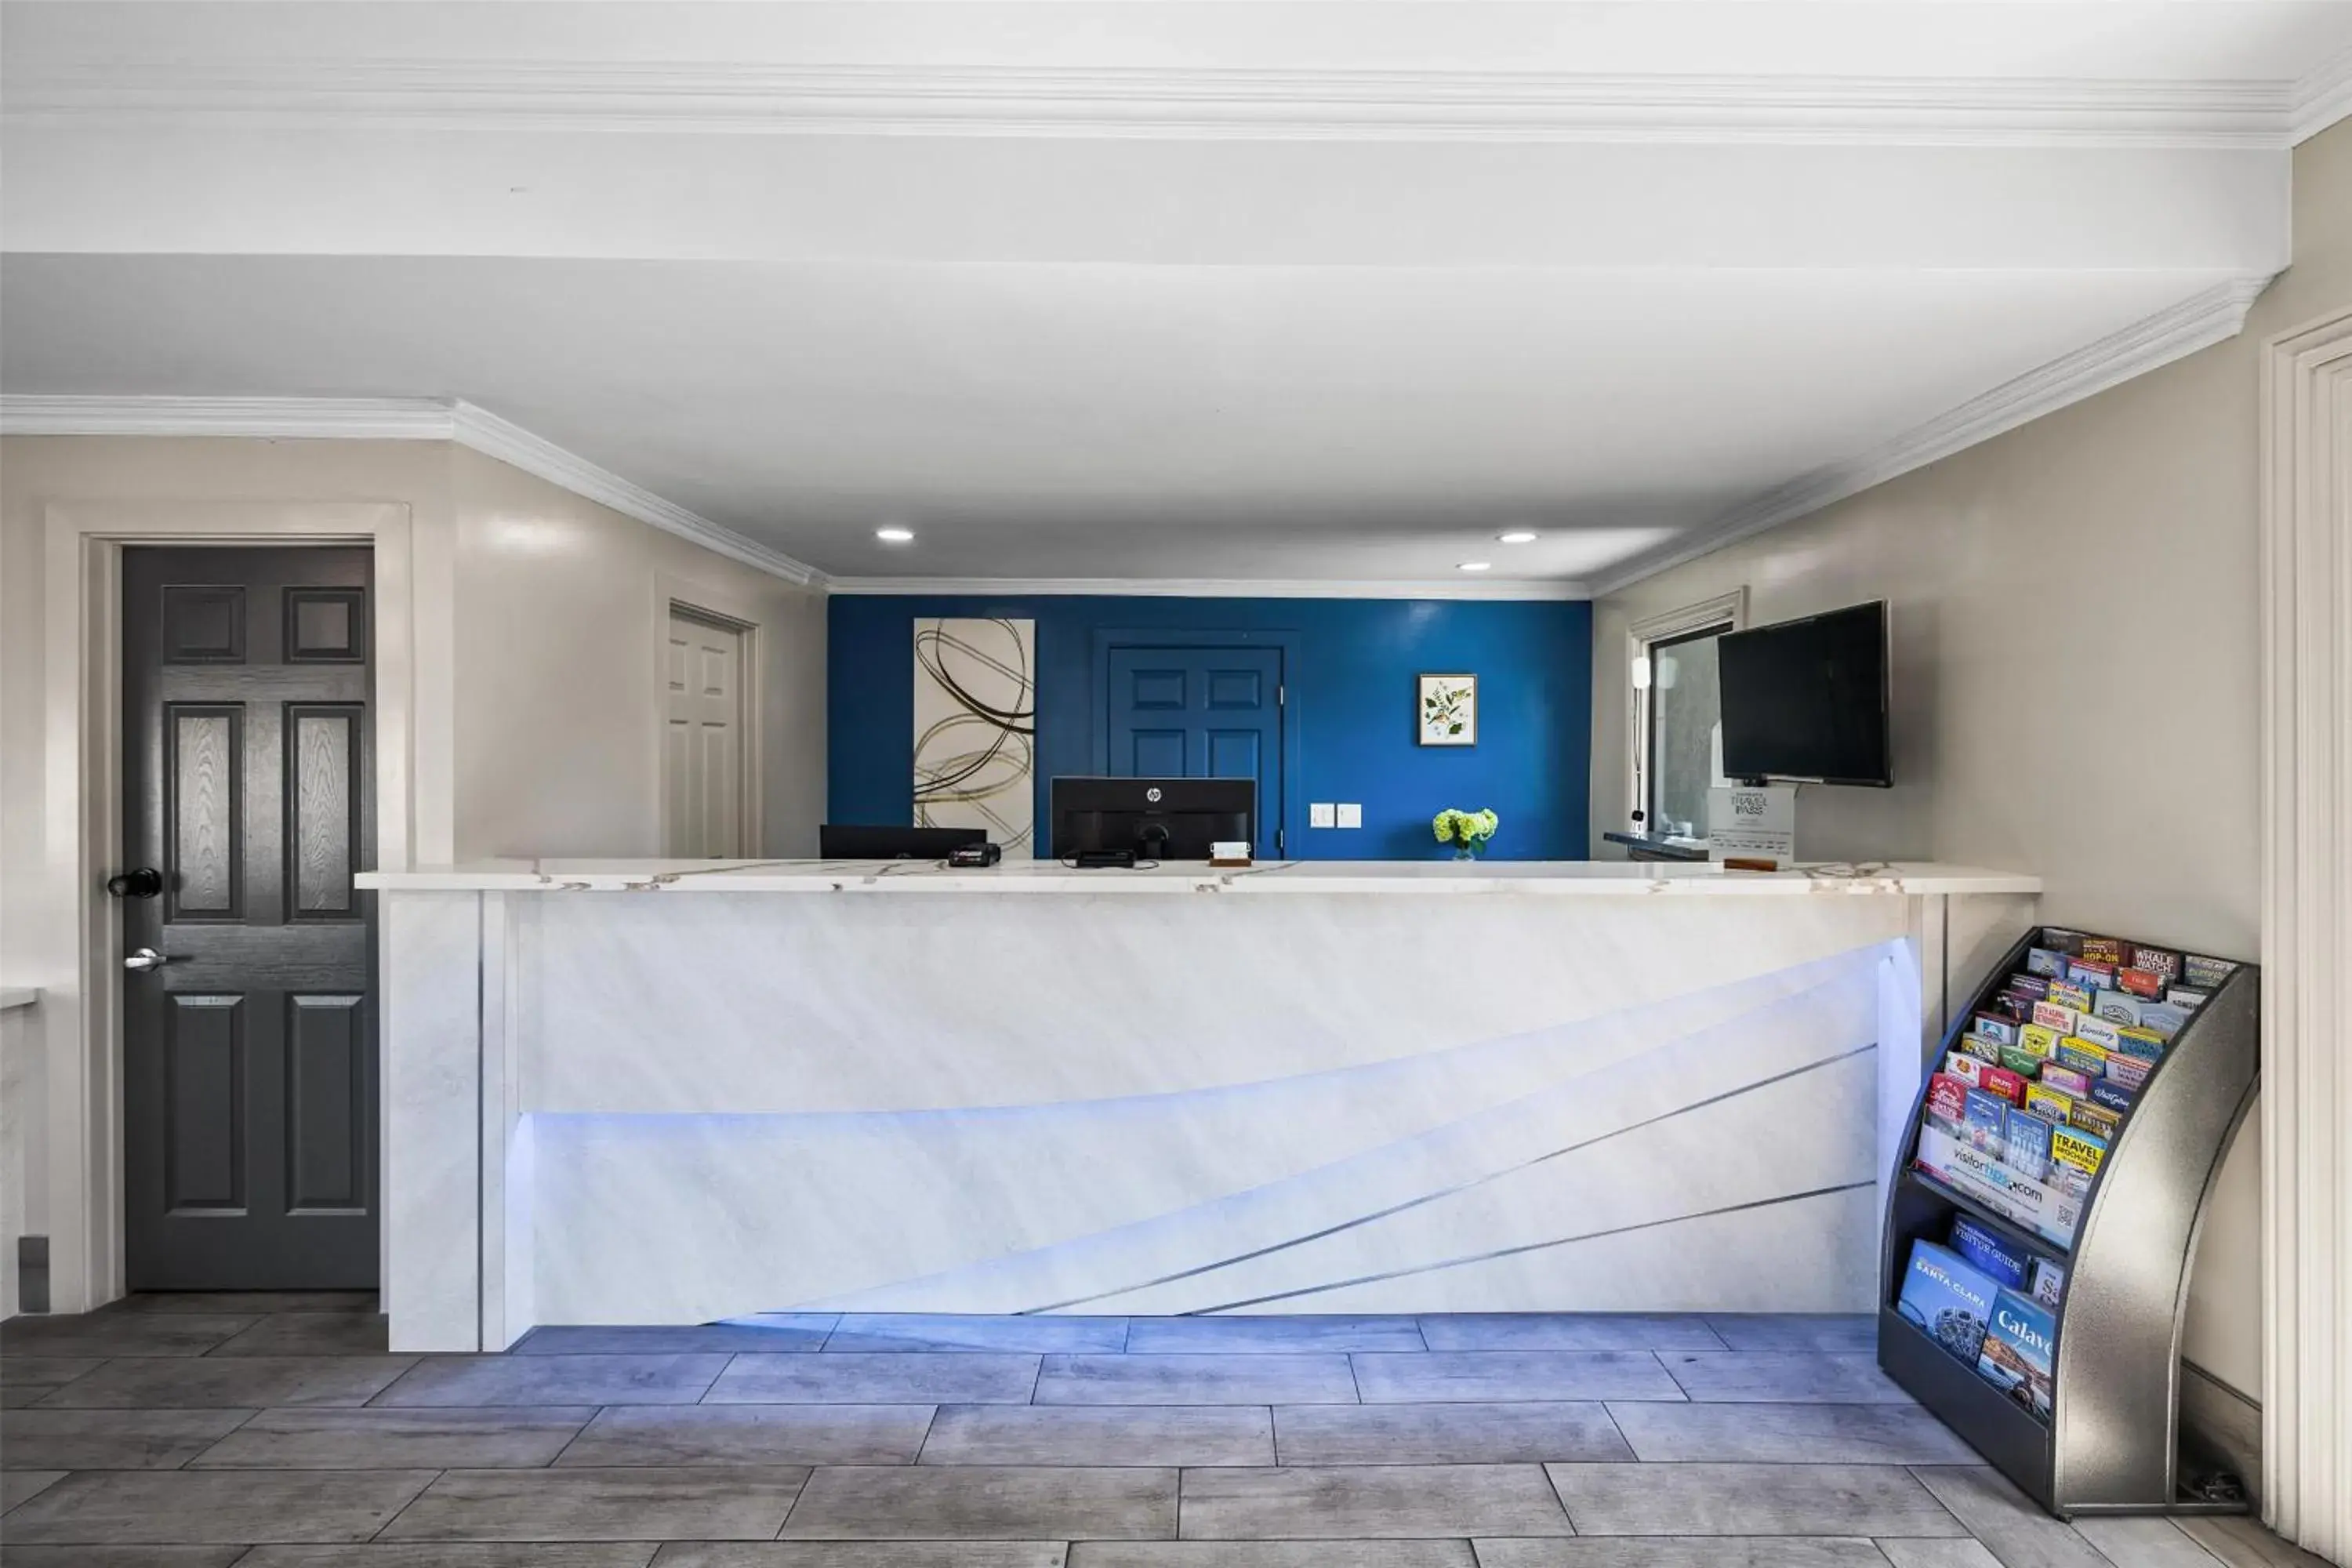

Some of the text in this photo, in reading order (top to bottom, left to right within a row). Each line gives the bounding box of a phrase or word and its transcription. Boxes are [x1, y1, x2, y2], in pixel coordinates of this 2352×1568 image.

[2082, 952, 2120, 964] HOP-ON
[2135, 949, 2174, 964] WHALE
[2056, 1134, 2099, 1160] TRAVEL
[1955, 1225, 1992, 1254] VISITOR
[1991, 1247, 2022, 1274] GUIDE
[1915, 1260, 1951, 1287] SANTA
[1953, 1282, 1986, 1308] CLARA
